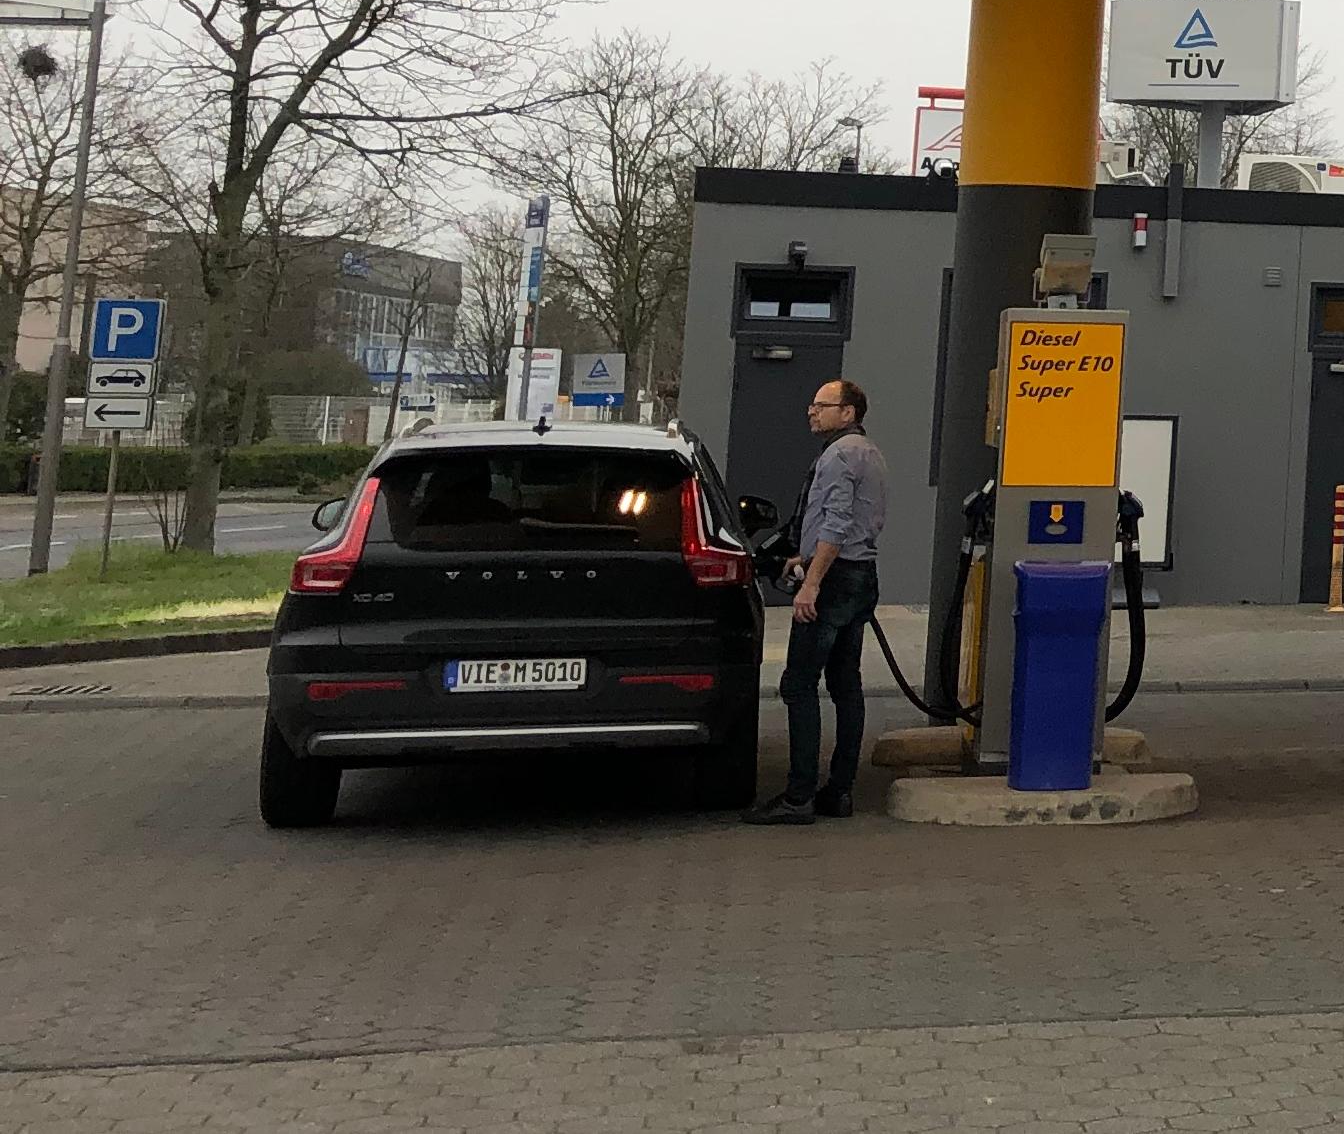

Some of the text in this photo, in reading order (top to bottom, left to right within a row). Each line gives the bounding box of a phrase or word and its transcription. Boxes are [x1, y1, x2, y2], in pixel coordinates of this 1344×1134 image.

[1165, 53, 1225, 79] TÜV
[107, 307, 144, 352] P
[1020, 329, 1081, 347] Diesel
[1017, 354, 1114, 377] Super E10
[1015, 381, 1074, 404] Super
[446, 570, 597, 580] VOLVO
[461, 663, 498, 684] VIE
[513, 662, 527, 683] M
[531, 661, 582, 683] 5010
